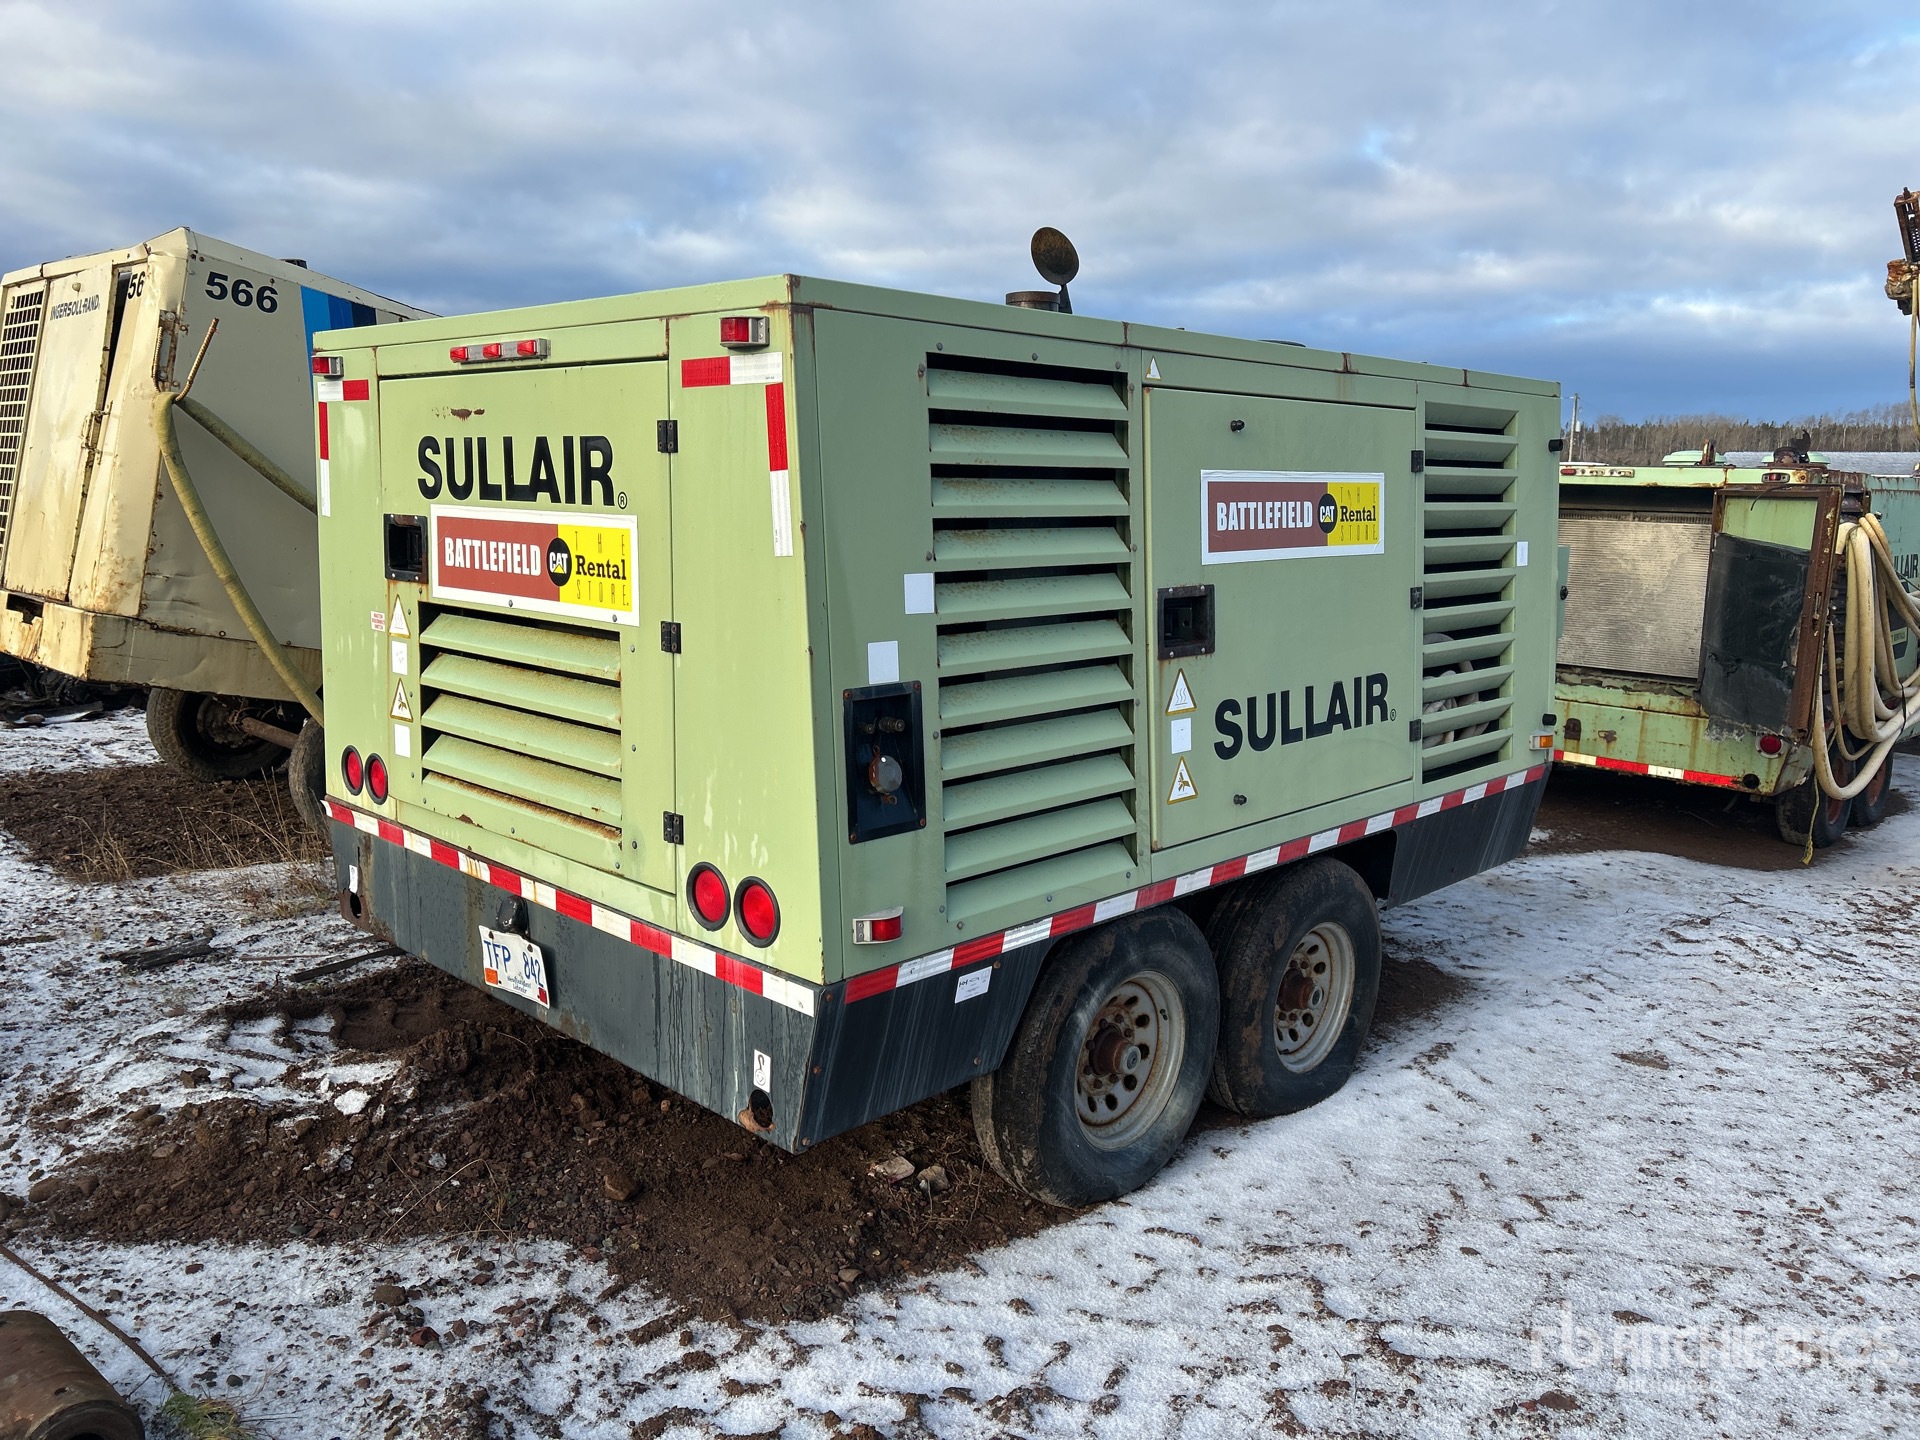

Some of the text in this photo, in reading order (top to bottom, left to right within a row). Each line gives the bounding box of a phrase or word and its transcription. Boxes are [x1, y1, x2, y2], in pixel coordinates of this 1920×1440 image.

[205, 270, 279, 314] 566
[417, 435, 616, 507] SULLAIR
[1216, 501, 1377, 531] BATTLEFIELD CAT Rental
[1340, 487, 1376, 504] THE
[444, 537, 627, 581] BATTLEFIELD CAT Rental
[574, 530, 626, 557] THE
[1213, 672, 1389, 760] SULLAIR
[484, 940, 544, 988] TFP 842
